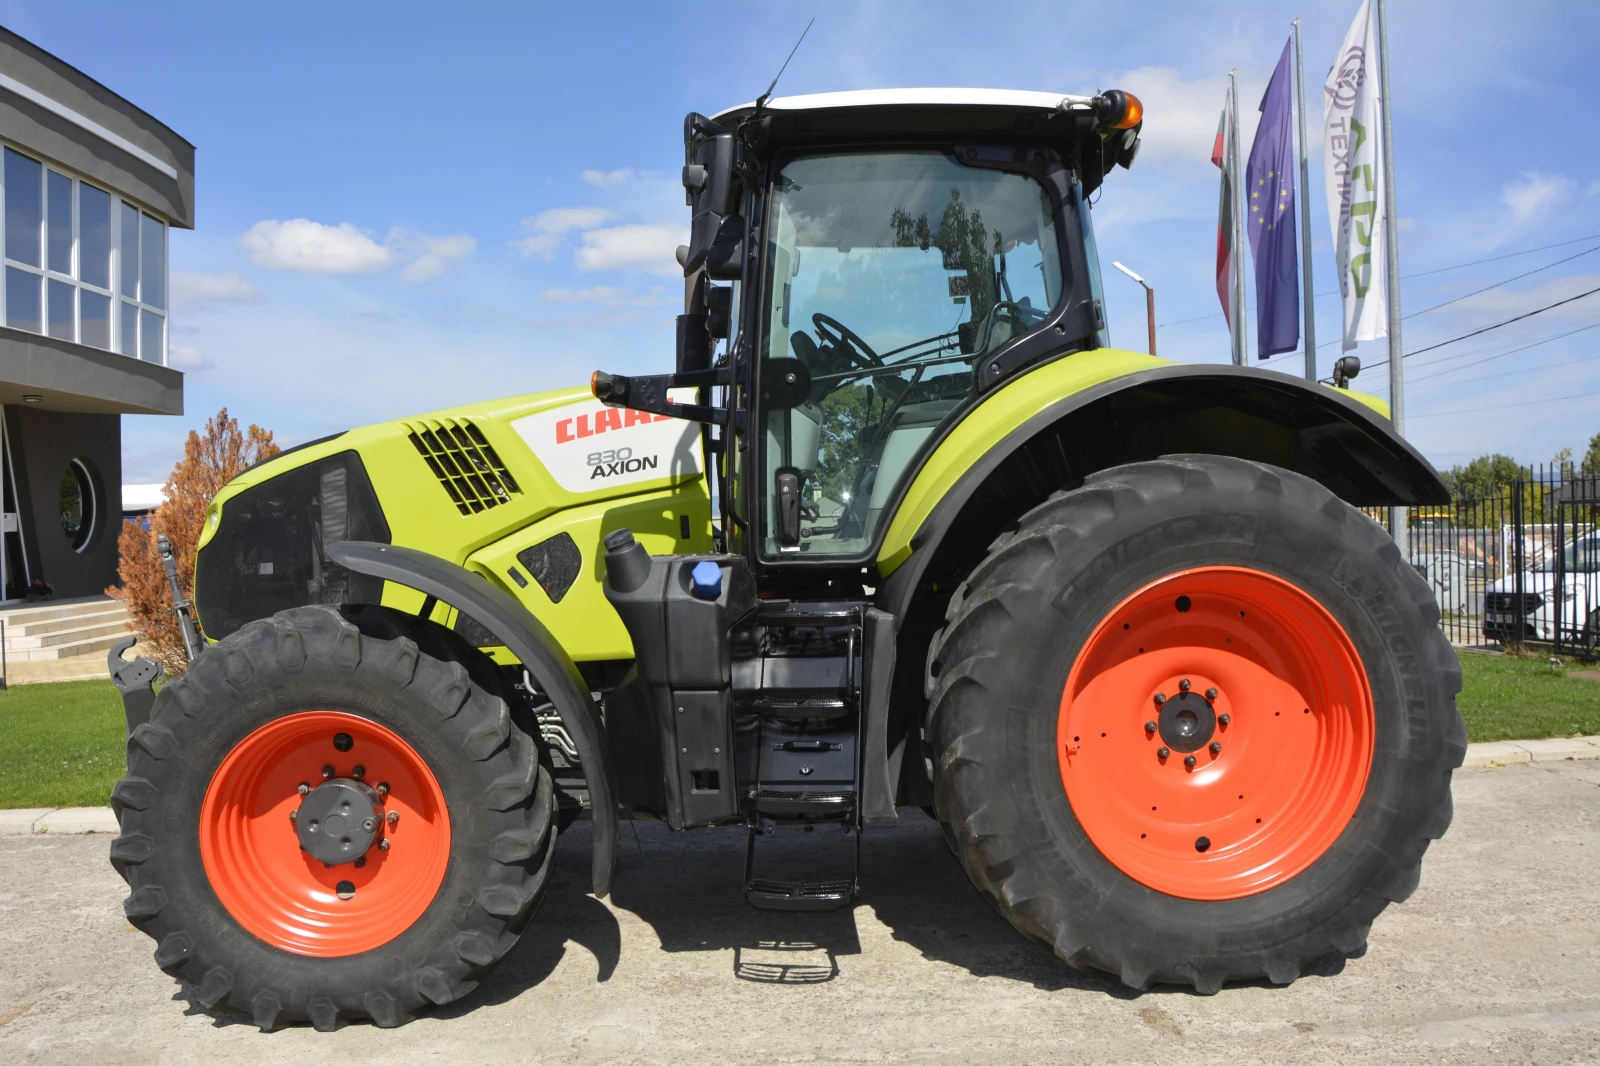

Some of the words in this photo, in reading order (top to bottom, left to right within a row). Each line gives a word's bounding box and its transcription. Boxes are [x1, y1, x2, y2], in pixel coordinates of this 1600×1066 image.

[586, 446, 633, 467] 830
[590, 455, 658, 480] AXION
[1364, 590, 1427, 759] MICHELIN
[349, 677, 470, 785] TRELLEBORG
